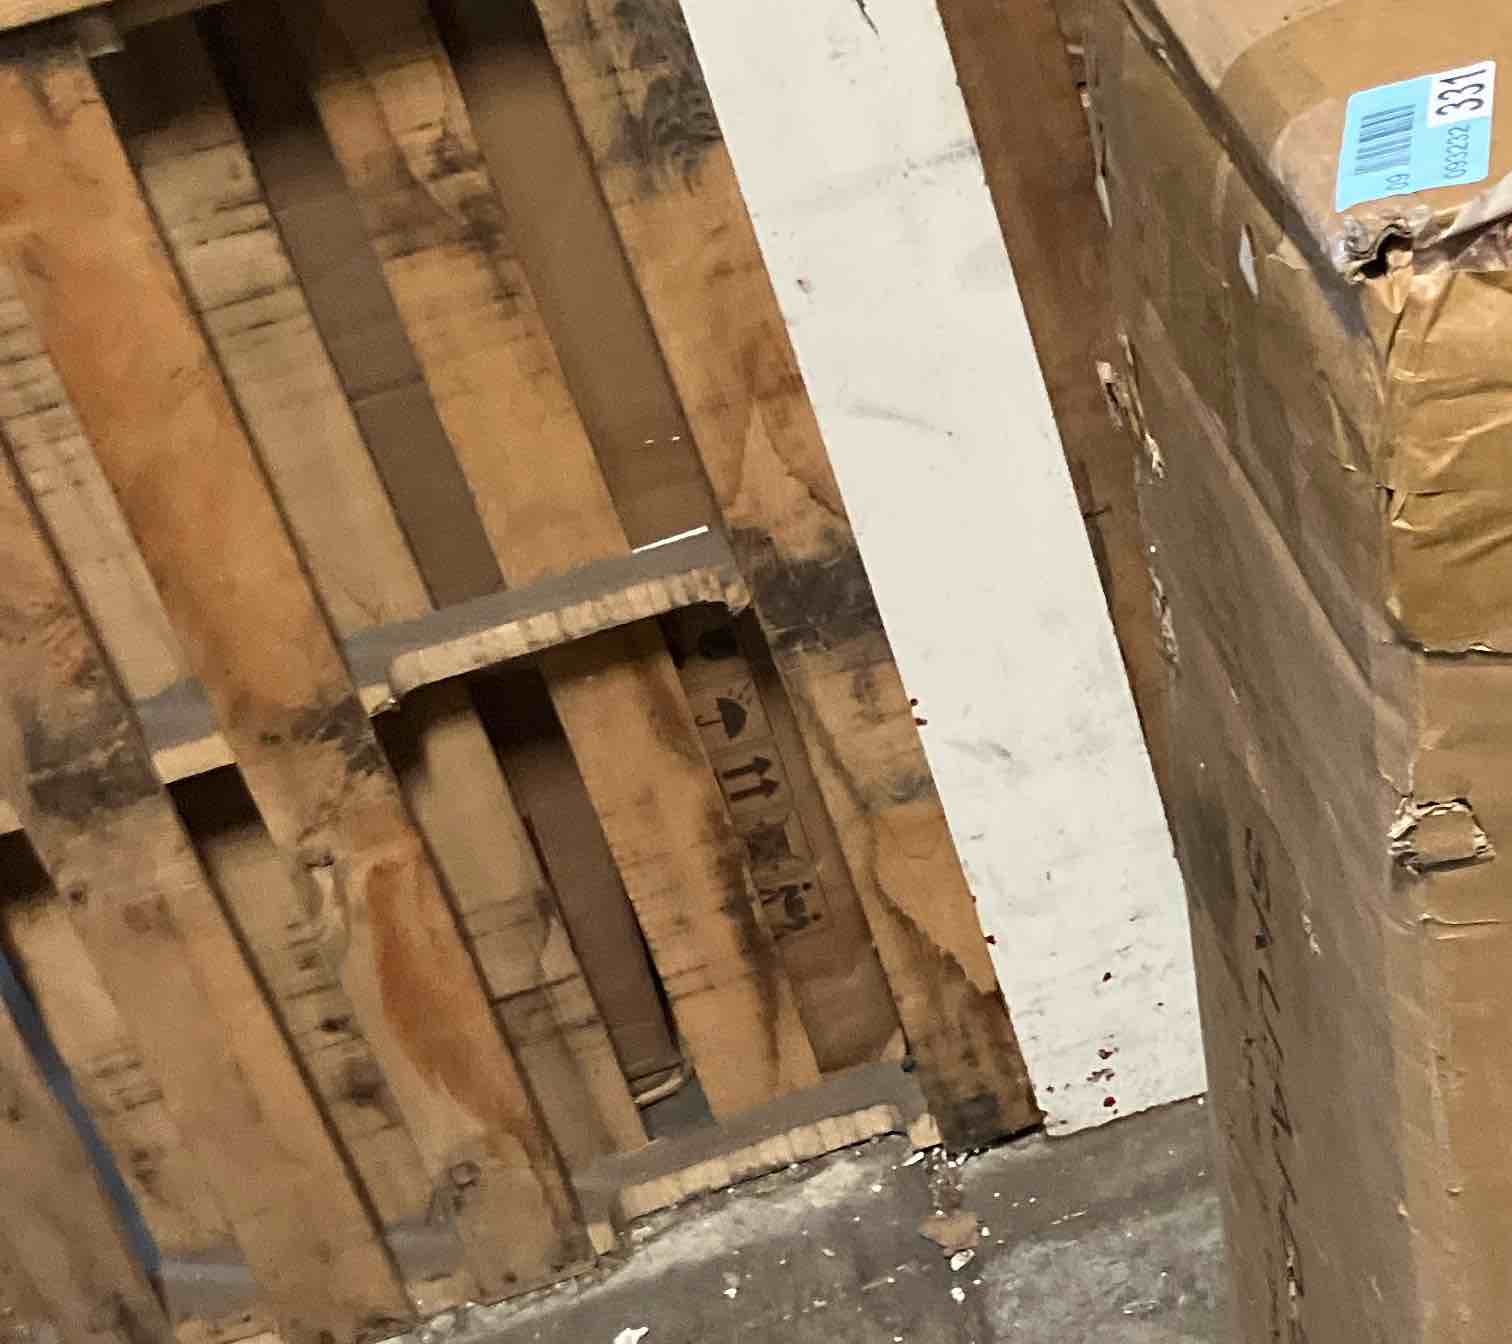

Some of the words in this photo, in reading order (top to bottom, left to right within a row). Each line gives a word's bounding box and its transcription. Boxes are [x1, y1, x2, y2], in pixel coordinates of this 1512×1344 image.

[1433, 67, 1487, 120] 331
[1384, 161, 1412, 194] 09
[1442, 124, 1471, 179] 093232
